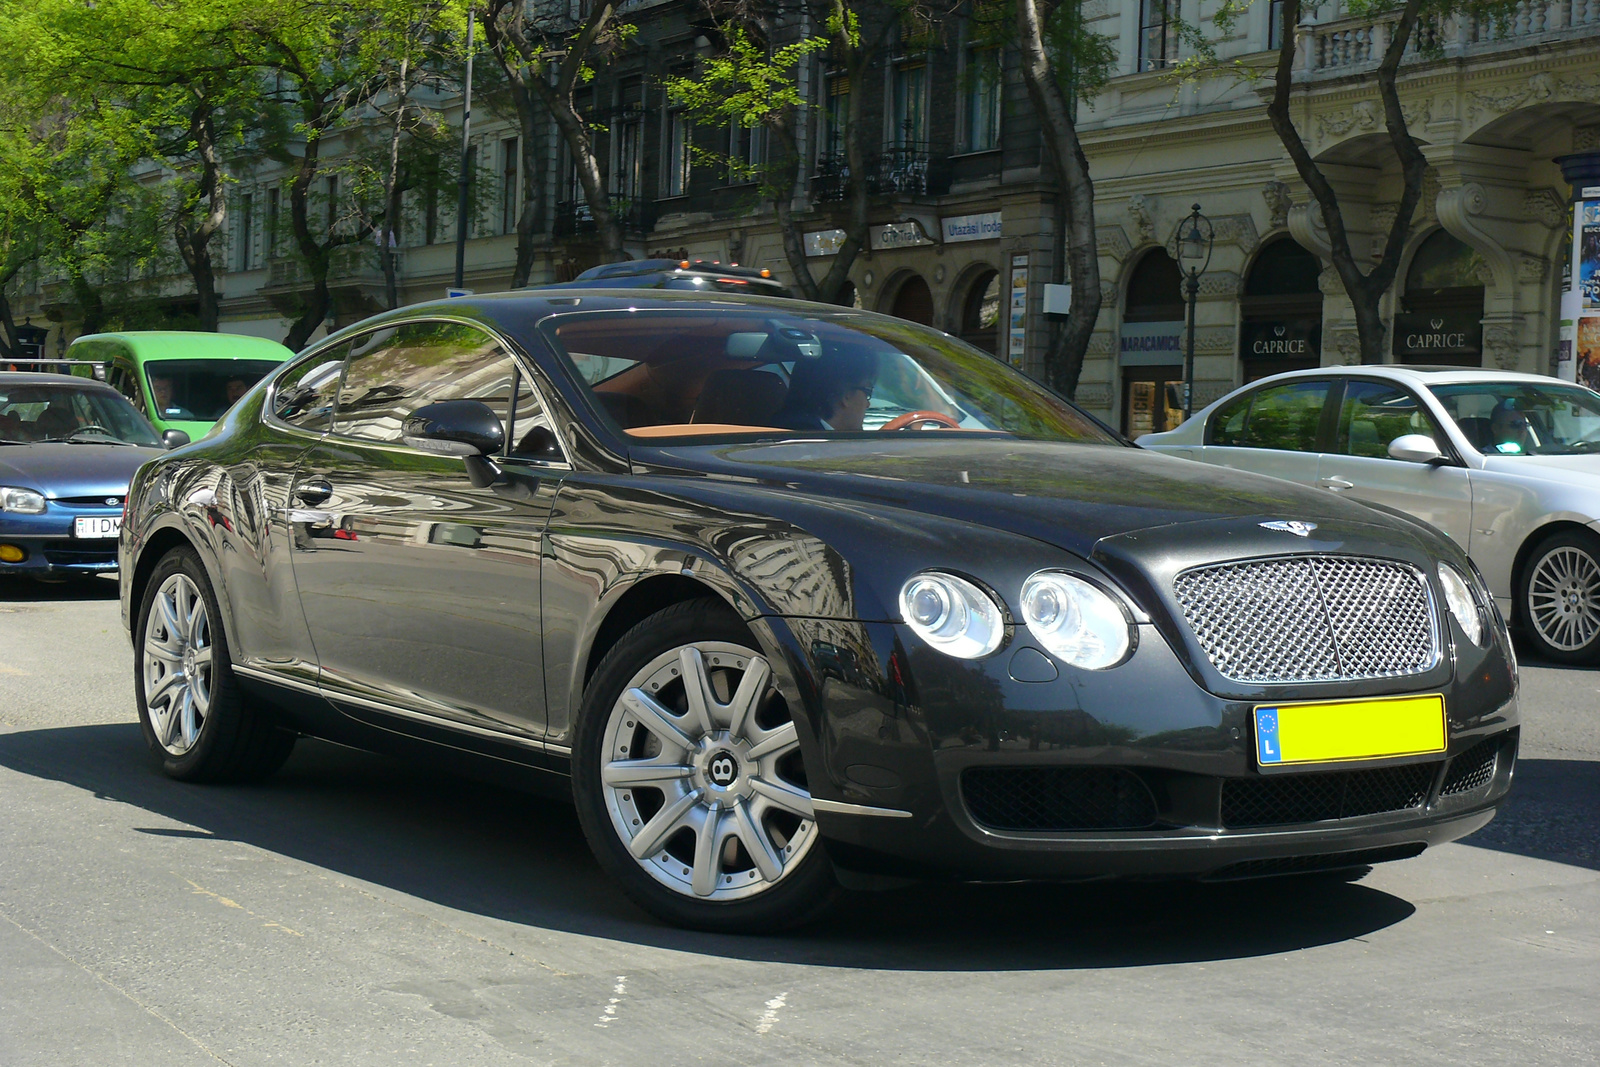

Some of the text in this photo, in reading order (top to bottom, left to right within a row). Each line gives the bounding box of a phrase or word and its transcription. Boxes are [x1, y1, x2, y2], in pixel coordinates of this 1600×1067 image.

[948, 219, 1001, 237] Utazási Iroda
[881, 230, 898, 243] OTP
[1253, 339, 1305, 354] CAPRICE
[1406, 333, 1465, 349] CAPRICE
[1264, 739, 1274, 755] L
